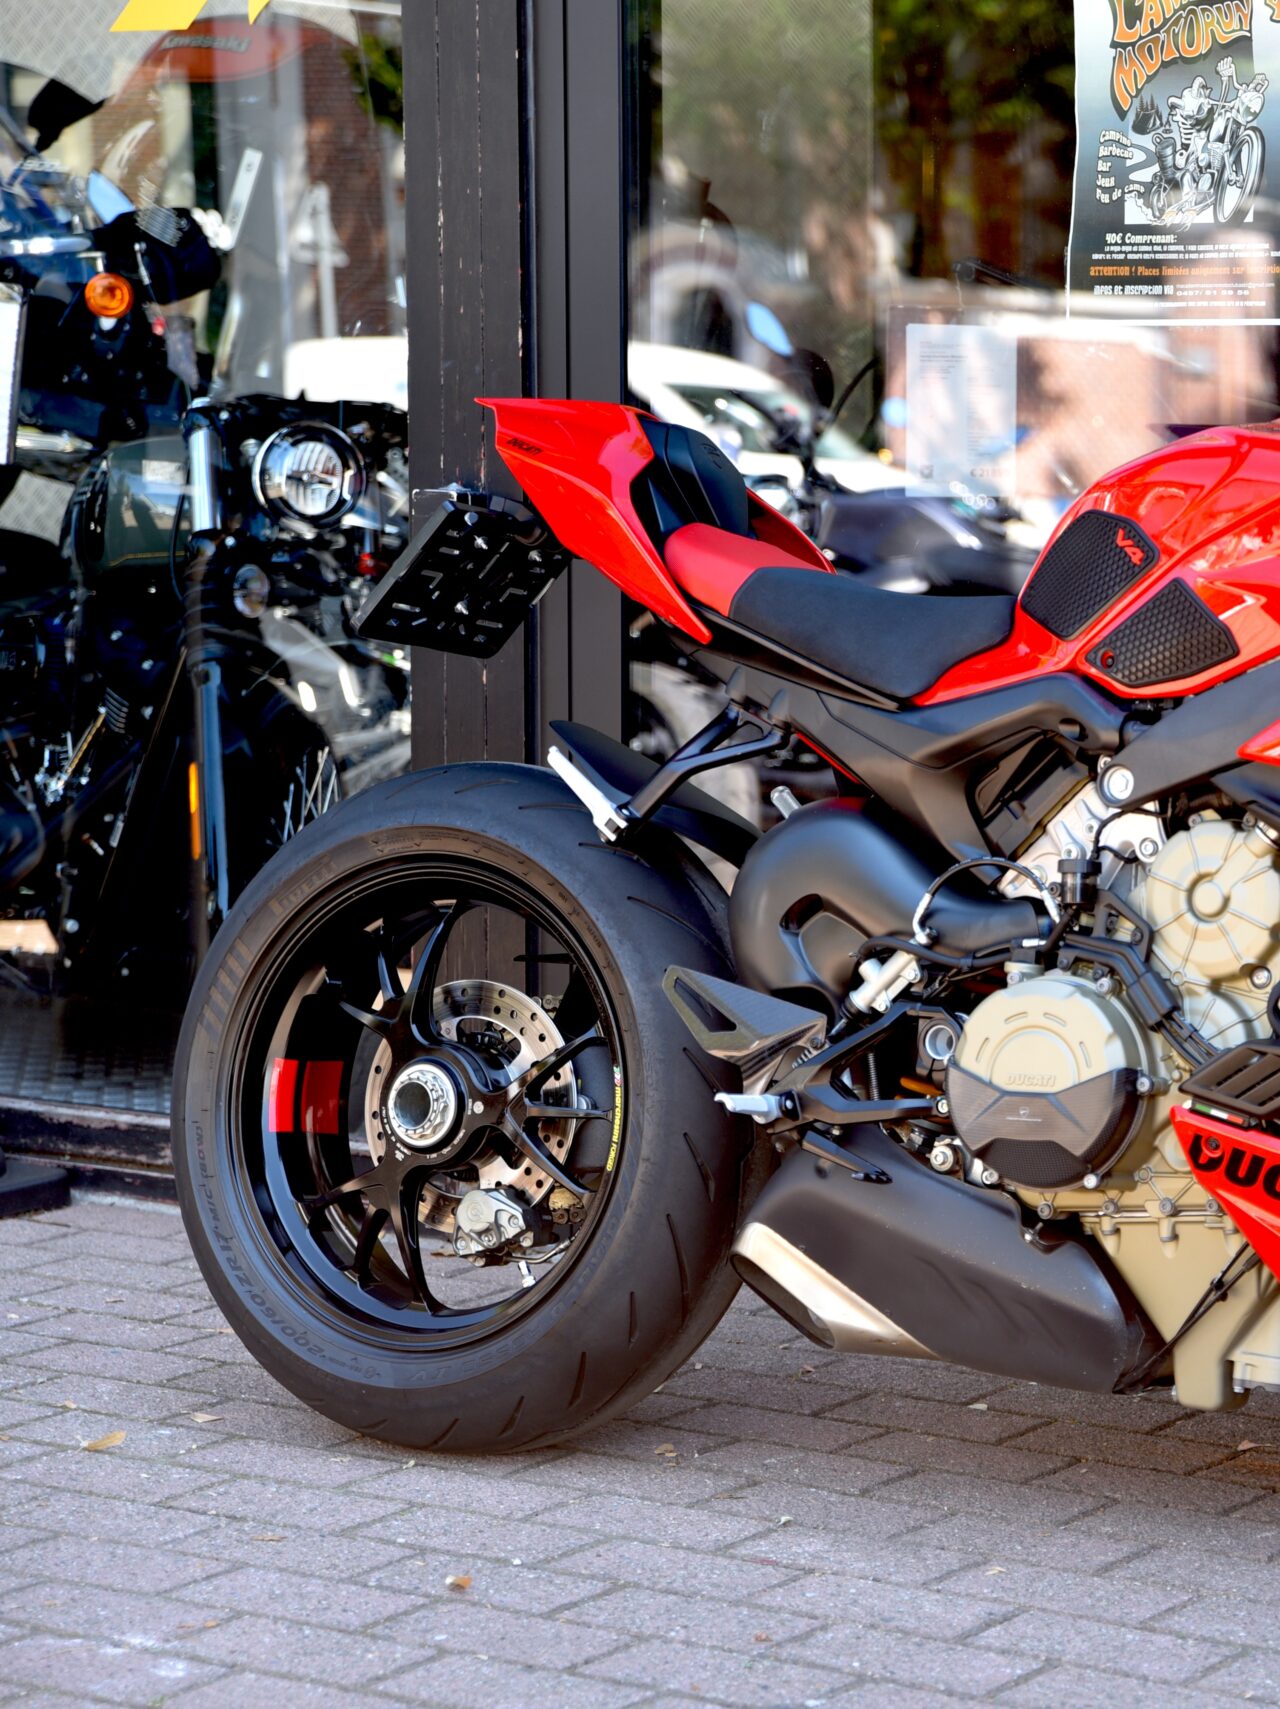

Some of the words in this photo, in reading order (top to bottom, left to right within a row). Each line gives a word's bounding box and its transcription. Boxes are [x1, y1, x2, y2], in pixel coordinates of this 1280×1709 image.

[1113, 1, 1251, 111] MOTORUN
[1099, 143, 1133, 158] Barbecue
[1097, 160, 1112, 171] Bar
[1096, 174, 1115, 188] Jeux
[1112, 188, 1122, 200] de
[1105, 233, 1123, 244] 40€
[1125, 233, 1177, 244] Comprenant:
[1137, 266, 1159, 276] Places
[1116, 528, 1145, 566] V4
[1006, 1073, 1056, 1087] DUCATI
